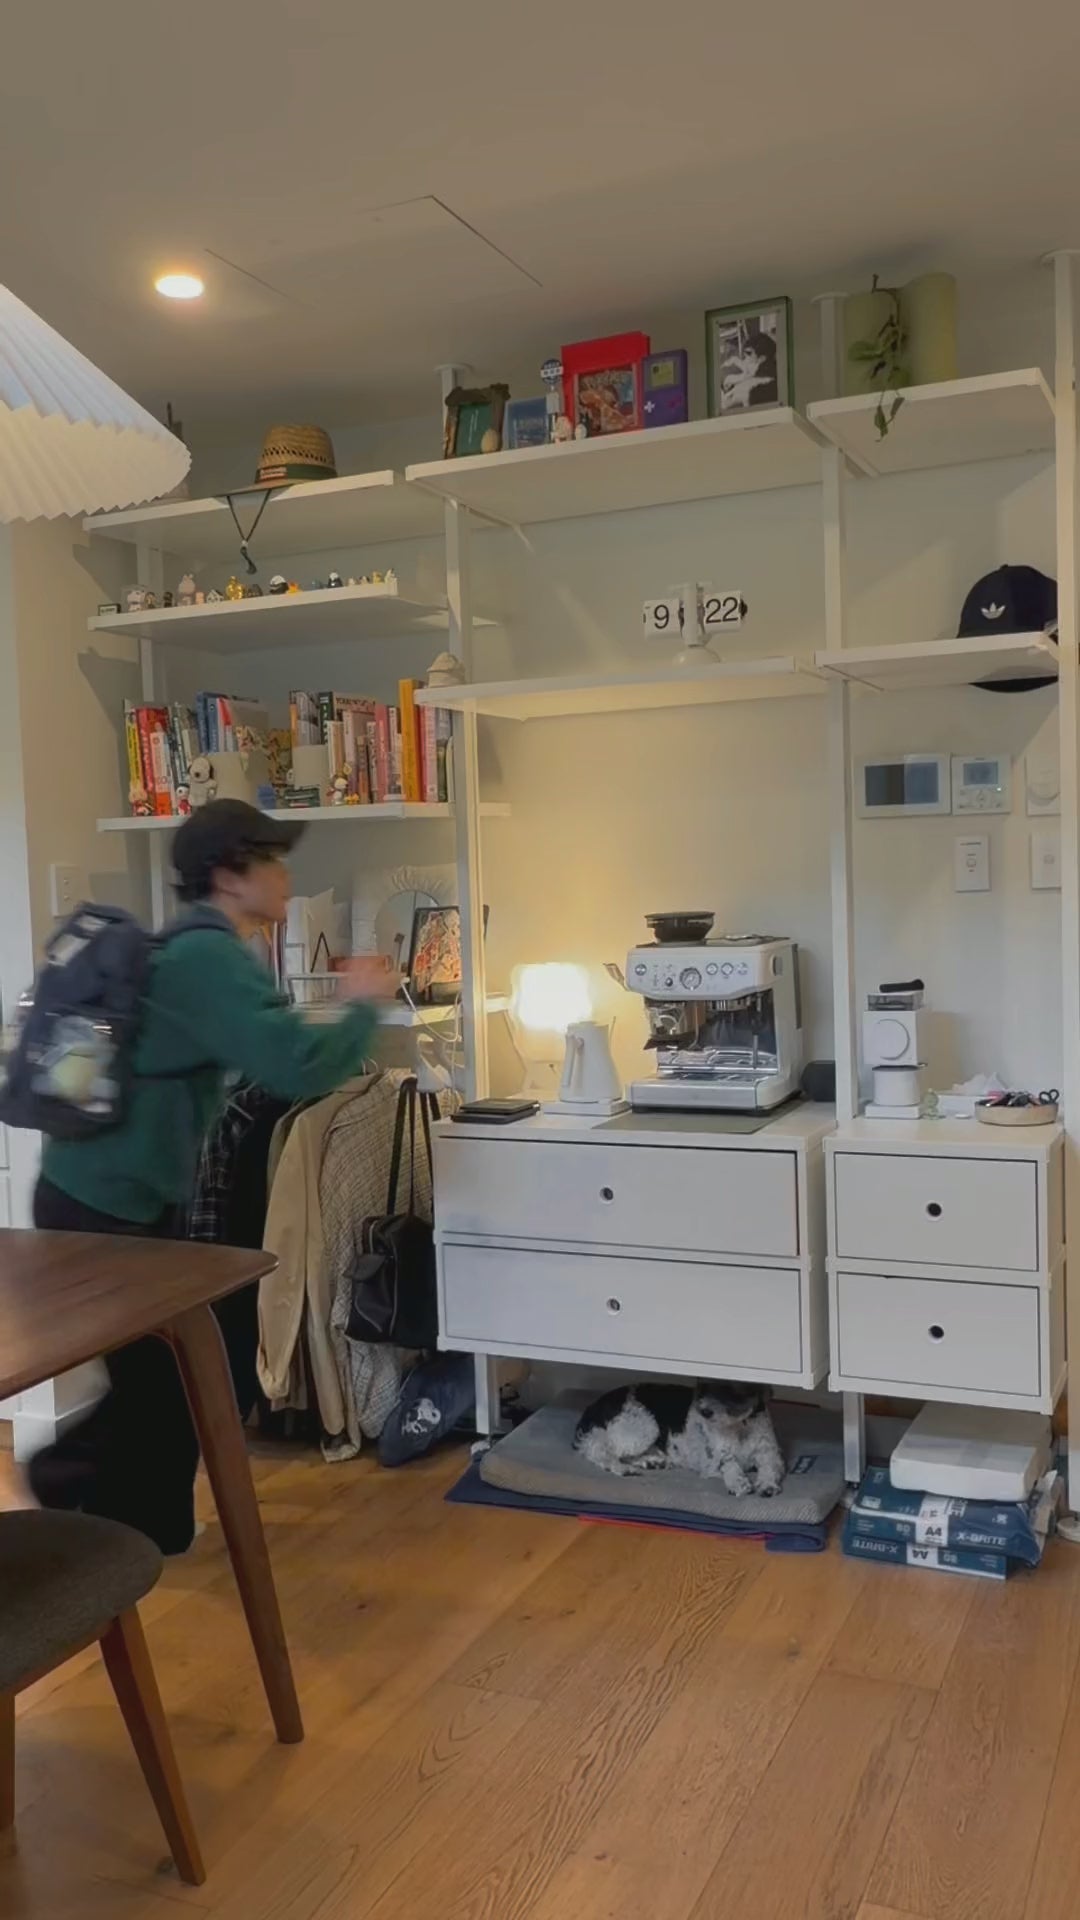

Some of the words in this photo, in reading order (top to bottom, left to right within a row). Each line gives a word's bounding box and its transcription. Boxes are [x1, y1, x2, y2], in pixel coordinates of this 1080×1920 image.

[654, 604, 669, 629] 9
[705, 597, 738, 624] 22
[925, 1526, 942, 1537] A4
[957, 1531, 1007, 1546] X-BRITE
